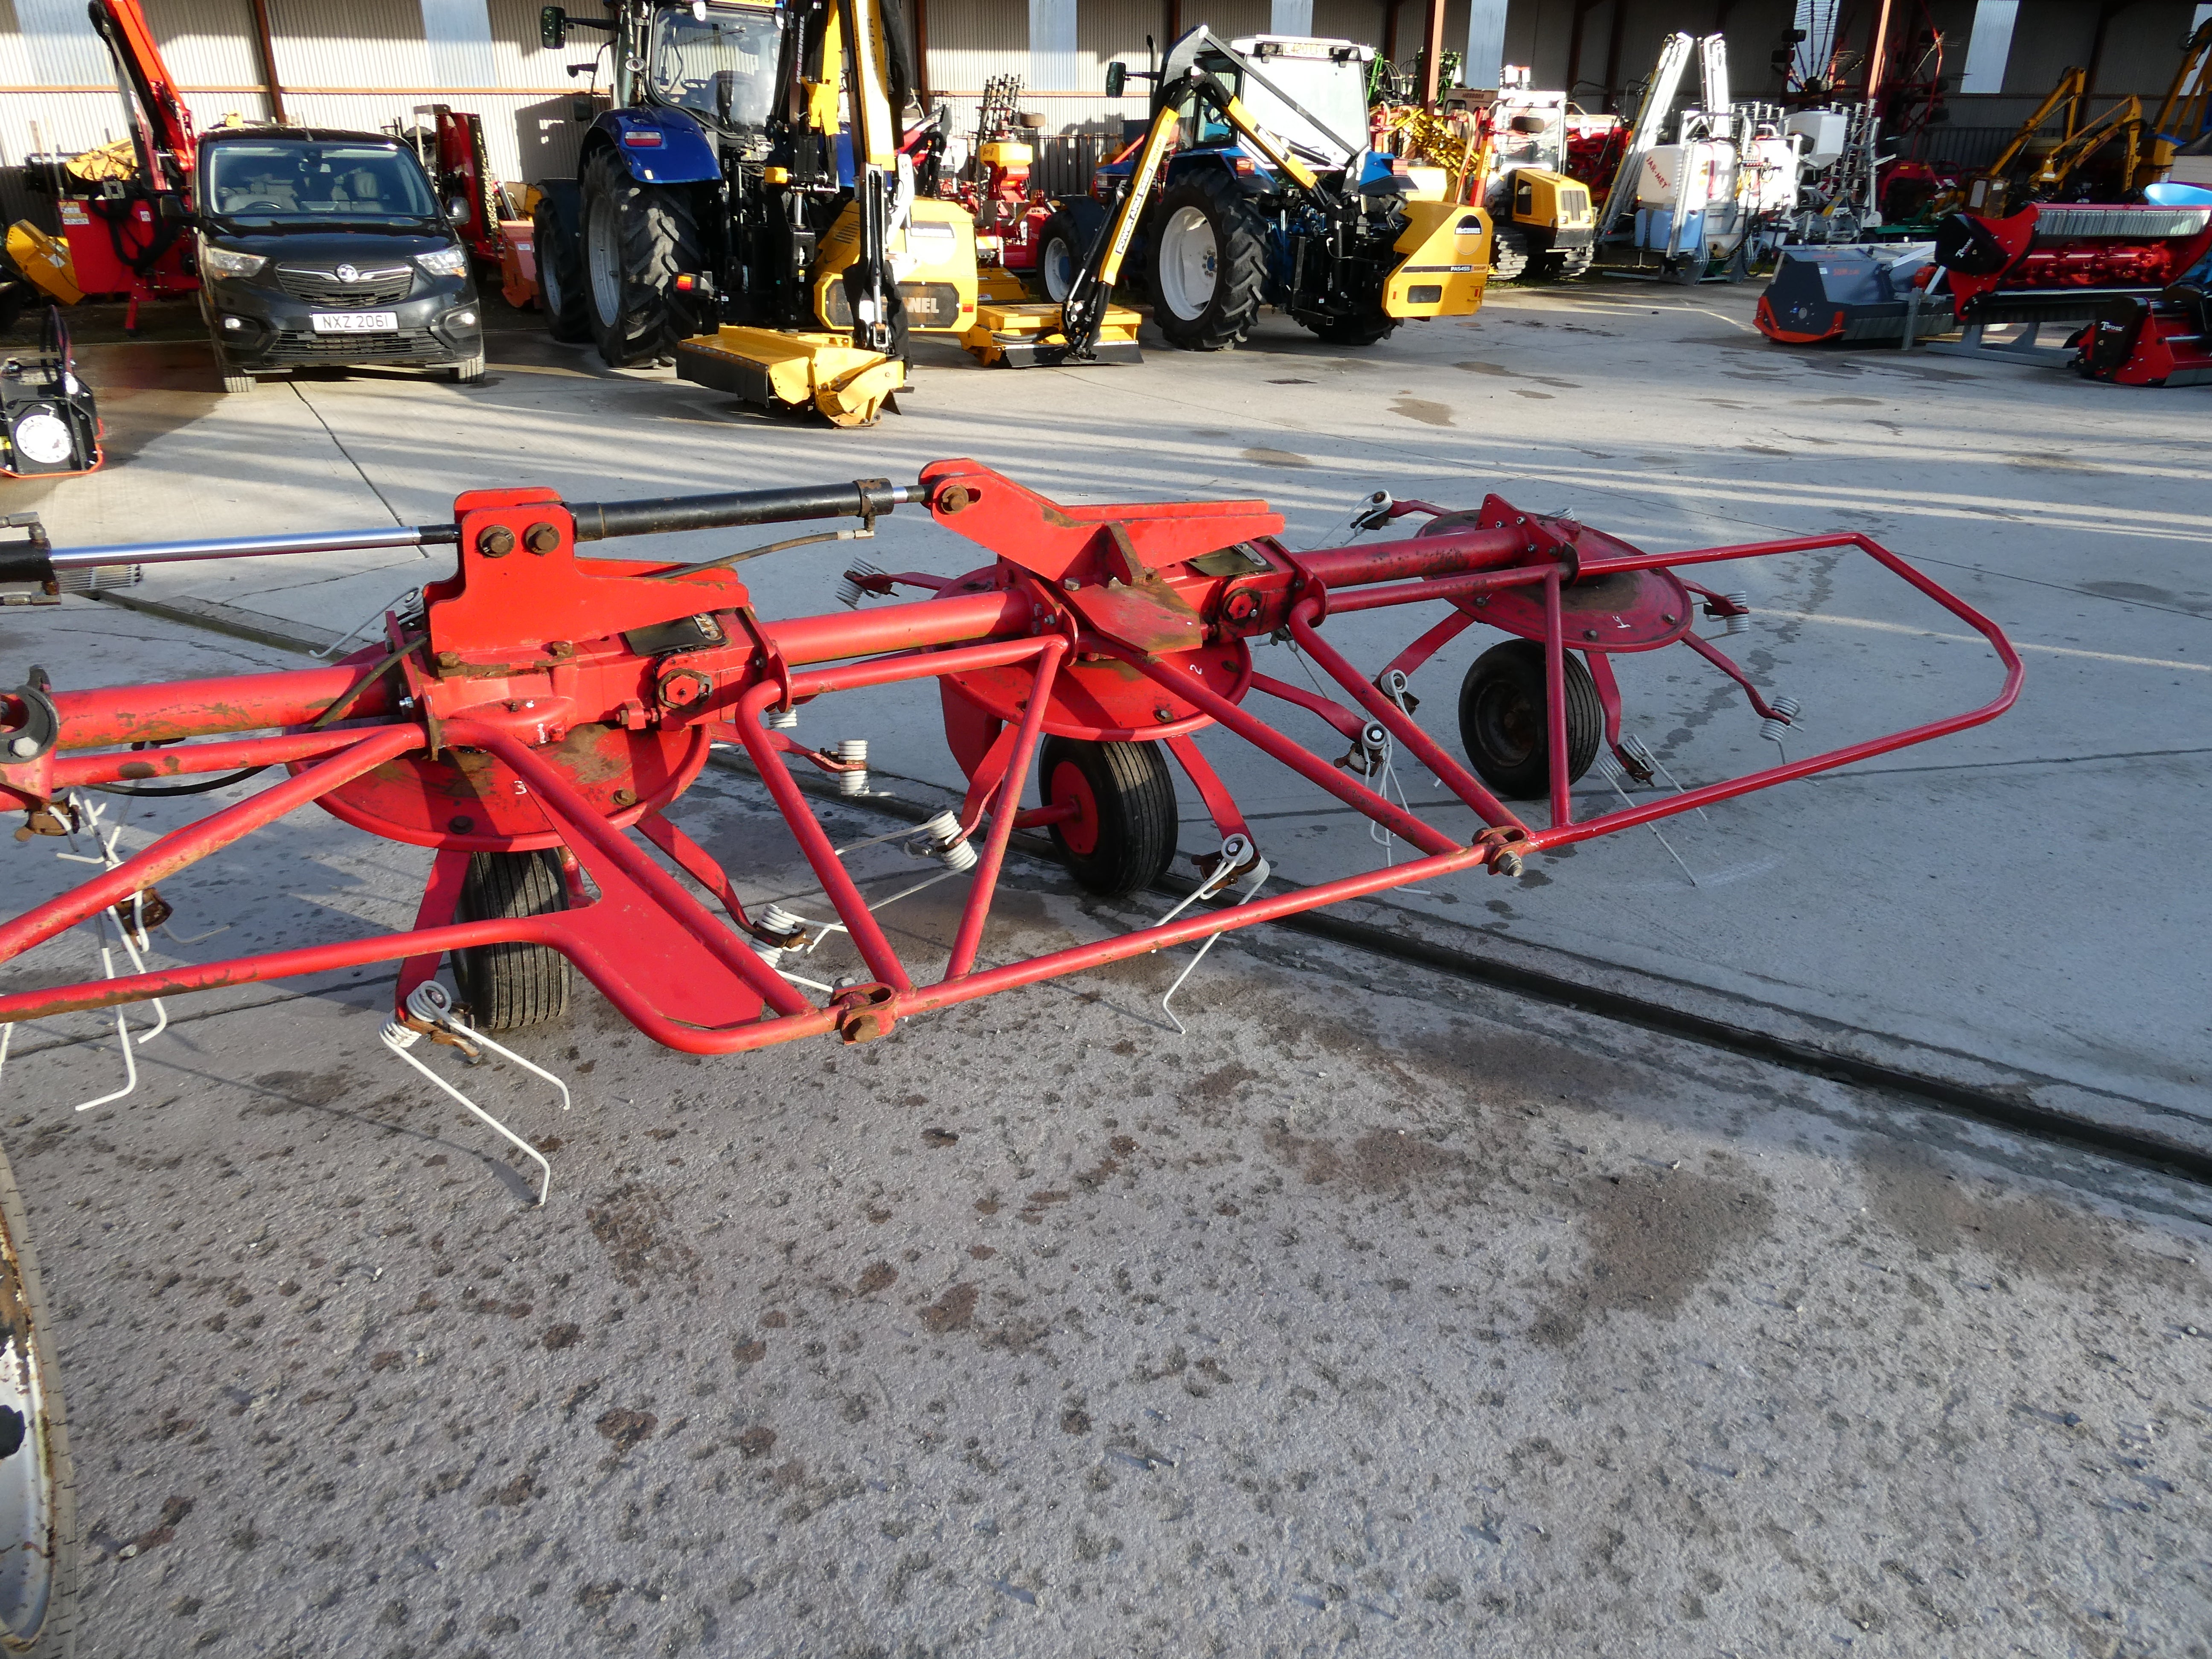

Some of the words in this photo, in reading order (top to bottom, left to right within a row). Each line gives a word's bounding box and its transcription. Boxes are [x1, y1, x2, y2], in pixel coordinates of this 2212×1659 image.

[1646, 156, 1668, 189] JAR-MET
[1116, 218, 1134, 254] POWER
[323, 316, 352, 329] NXZ
[356, 314, 388, 328] 2061
[1189, 664, 1202, 675] 2
[514, 780, 527, 795] 3
